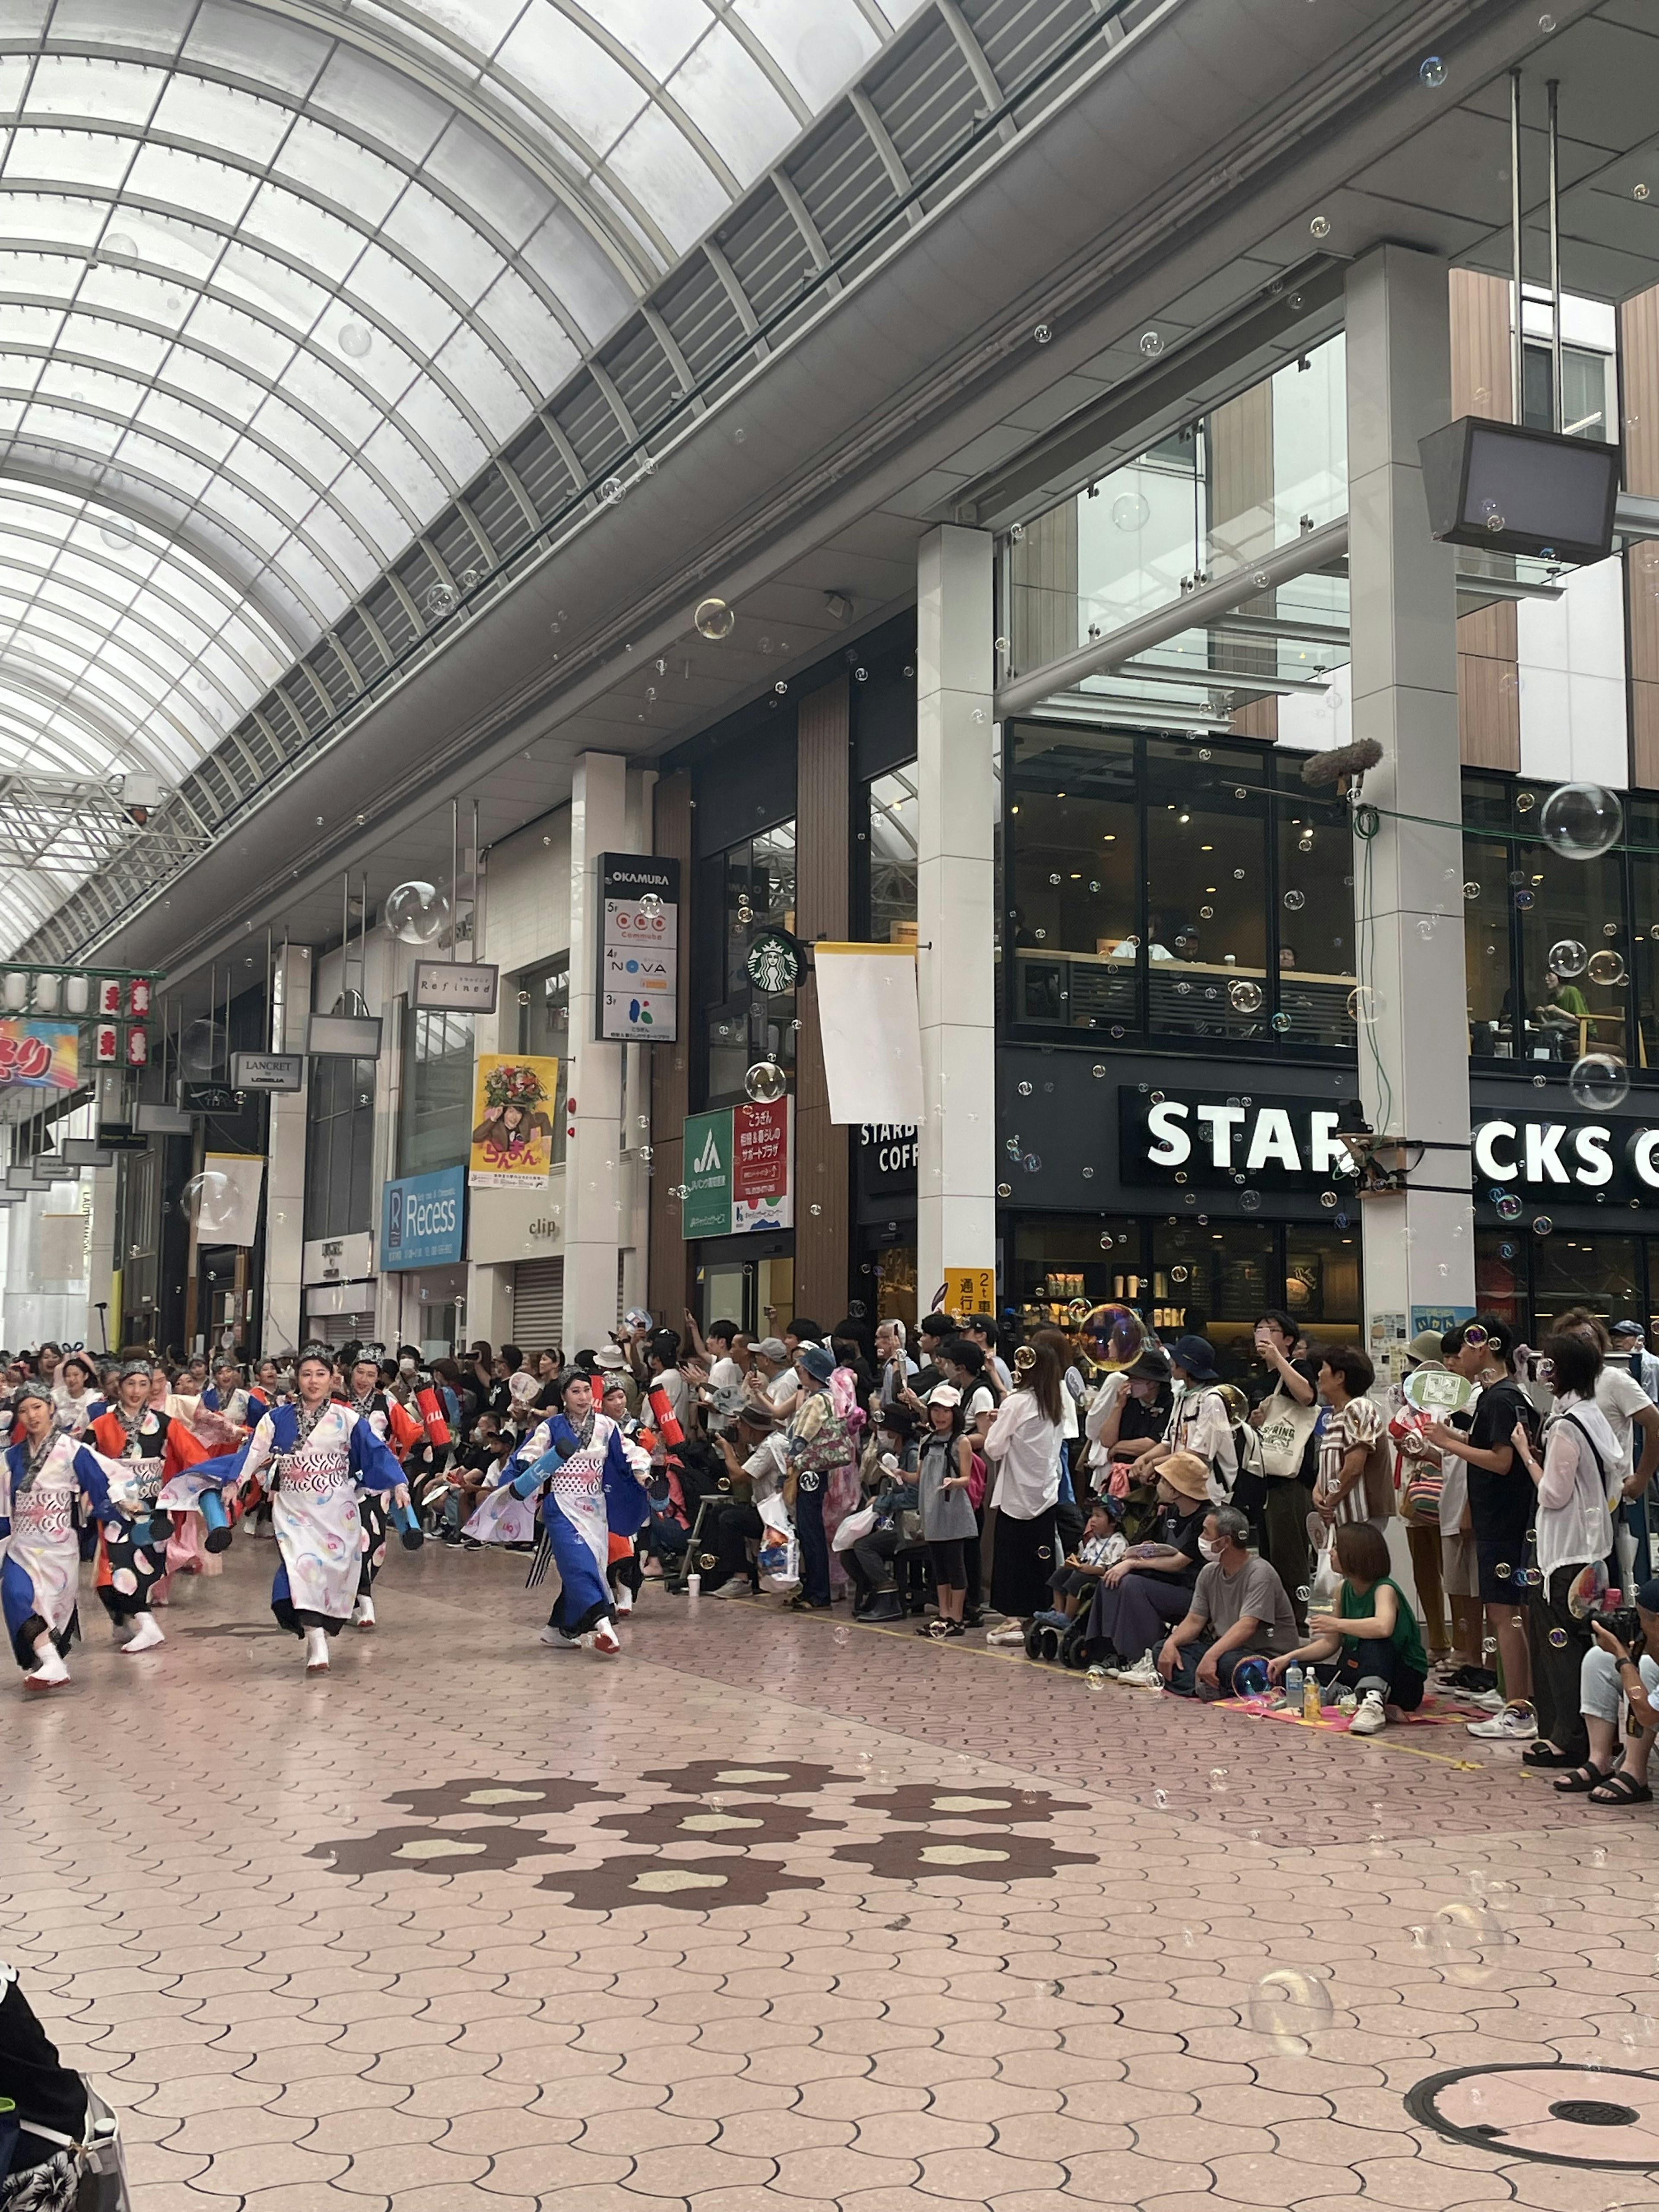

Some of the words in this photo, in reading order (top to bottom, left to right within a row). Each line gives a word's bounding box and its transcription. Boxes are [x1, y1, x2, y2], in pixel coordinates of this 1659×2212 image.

[613, 871, 669, 885] OKAMURA
[611, 959, 667, 974] NOVA
[421, 980, 490, 993] Refined
[246, 1061, 292, 1071] LANCRET
[483, 1139, 537, 1170] らんまん
[406, 1194, 456, 1238] Recess
[529, 1217, 556, 1237] clip
[960, 1278, 973, 1317] 通行
